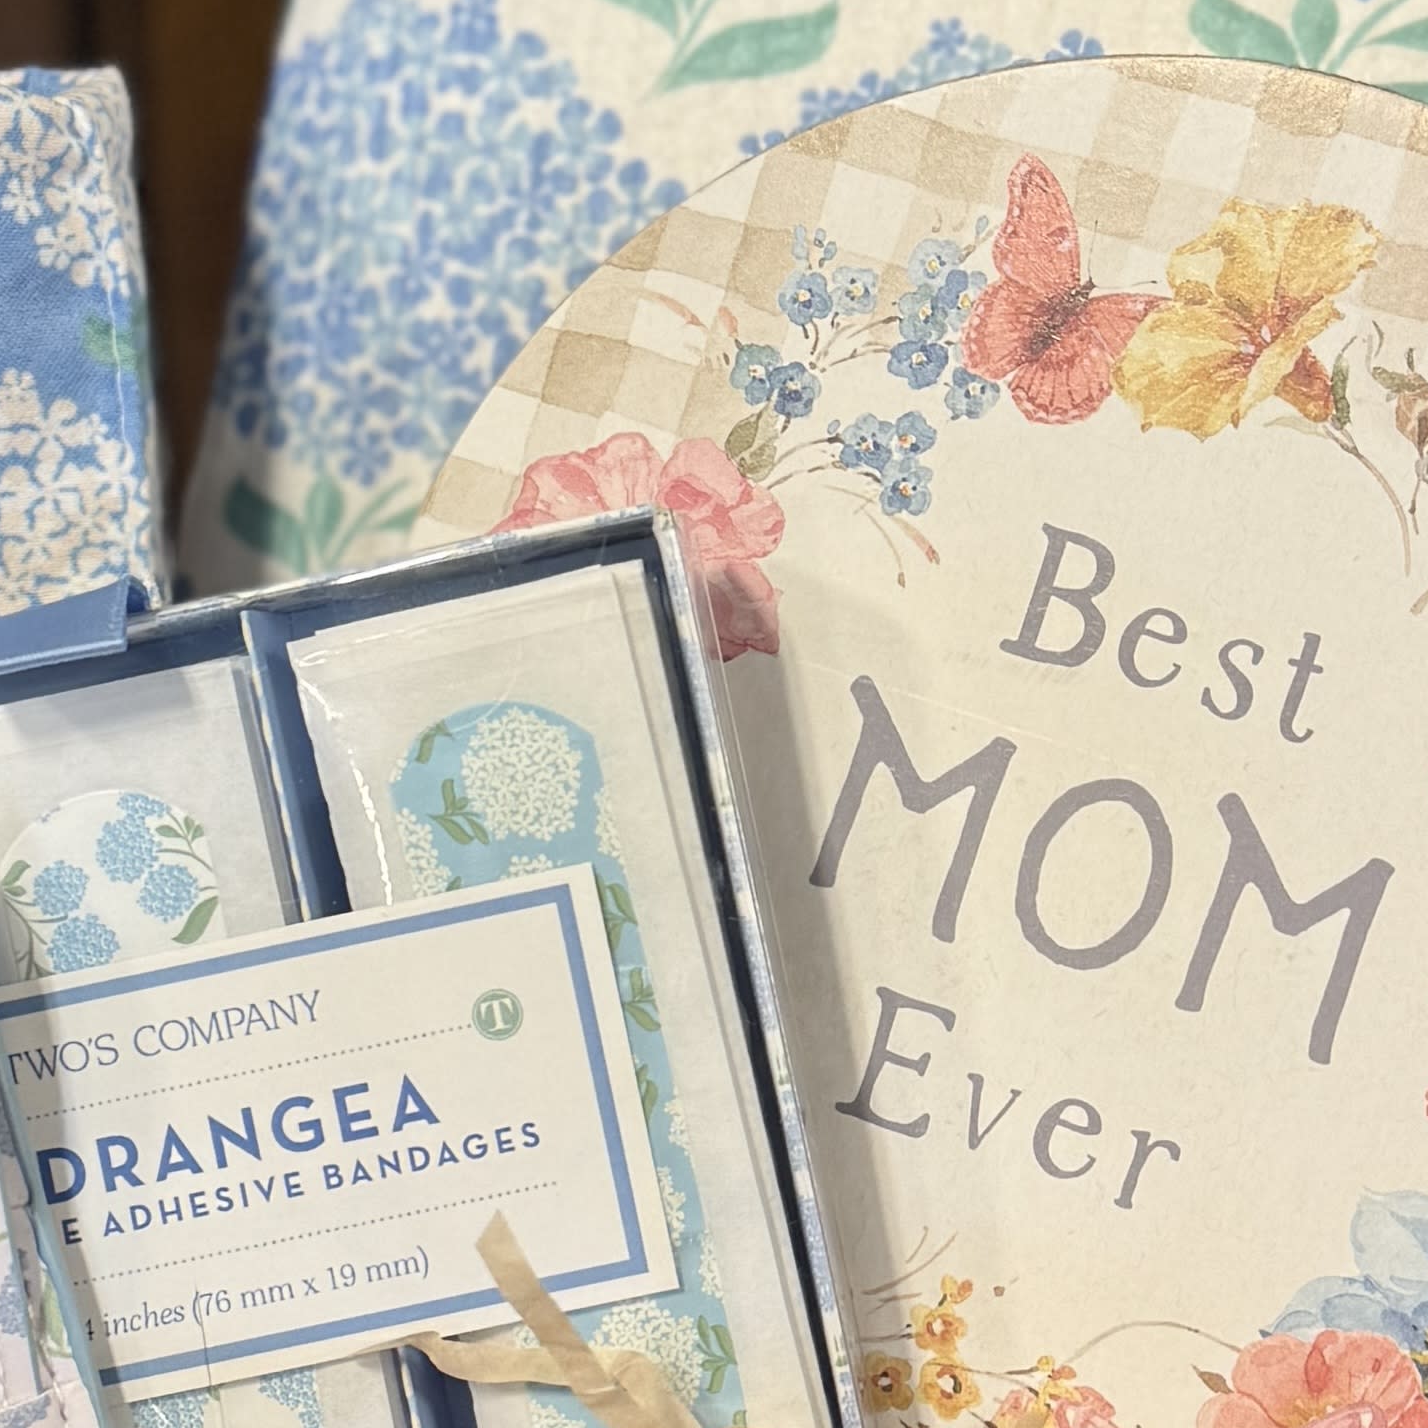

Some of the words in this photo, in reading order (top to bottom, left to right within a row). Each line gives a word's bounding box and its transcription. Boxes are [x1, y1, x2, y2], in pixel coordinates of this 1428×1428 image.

[999, 523, 1324, 744] Best
[808, 675, 1396, 1065] MOM
[133, 989, 320, 1057] COMPANY
[36, 1074, 440, 1206] DRANGEA
[835, 986, 1181, 1210] Ever
[103, 1171, 304, 1237] ADHESIVE
[323, 1122, 540, 1190] BANDAGES
[103, 1302, 185, 1338] inches
[192, 1290, 231, 1327] (76
[241, 1279, 294, 1308] mm
[304, 1277, 319, 1297] x
[326, 1263, 356, 1289] 19
[366, 1245, 429, 1283] mm)
